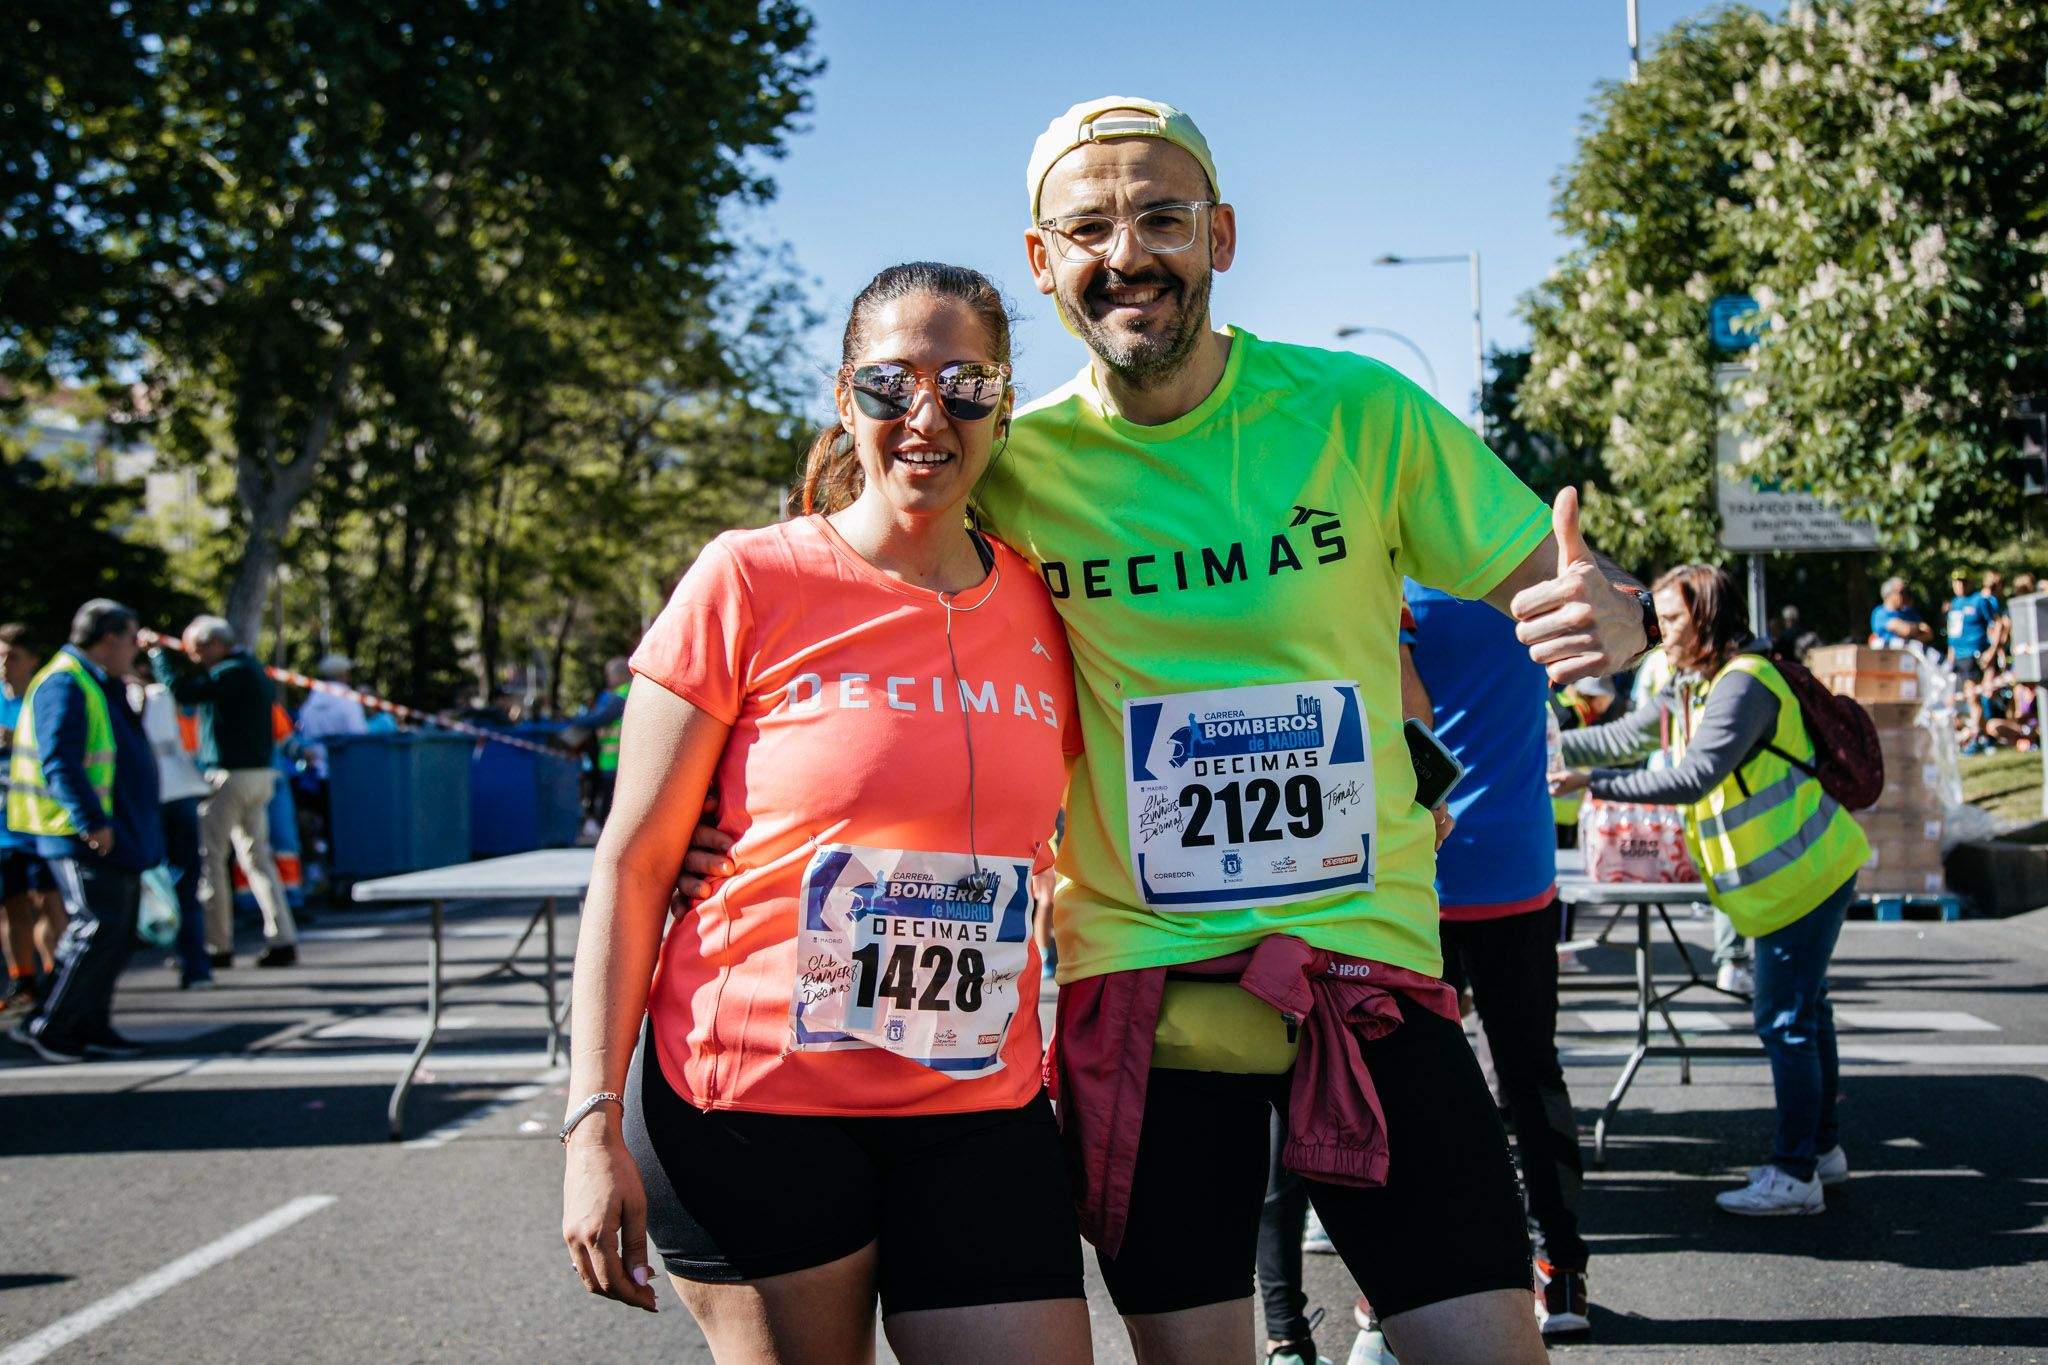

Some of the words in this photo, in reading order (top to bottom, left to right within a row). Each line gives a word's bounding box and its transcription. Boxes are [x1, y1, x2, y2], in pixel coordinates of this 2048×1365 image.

[1041, 519, 1347, 599] DECIMAS
[786, 672, 1058, 729] DECIMAS
[1204, 709, 1245, 721] CARRERA
[1204, 714, 1318, 739] BOMBEROS
[1248, 735, 1265, 752] de
[1269, 730, 1320, 750] MADRID
[1194, 750, 1318, 777] DECIMAS
[1178, 774, 1324, 848] 2129
[893, 872, 934, 881] CARRERA
[946, 902, 990, 921] MADRID
[873, 917, 987, 942] DECIMAS
[851, 942, 986, 1013] 1428
